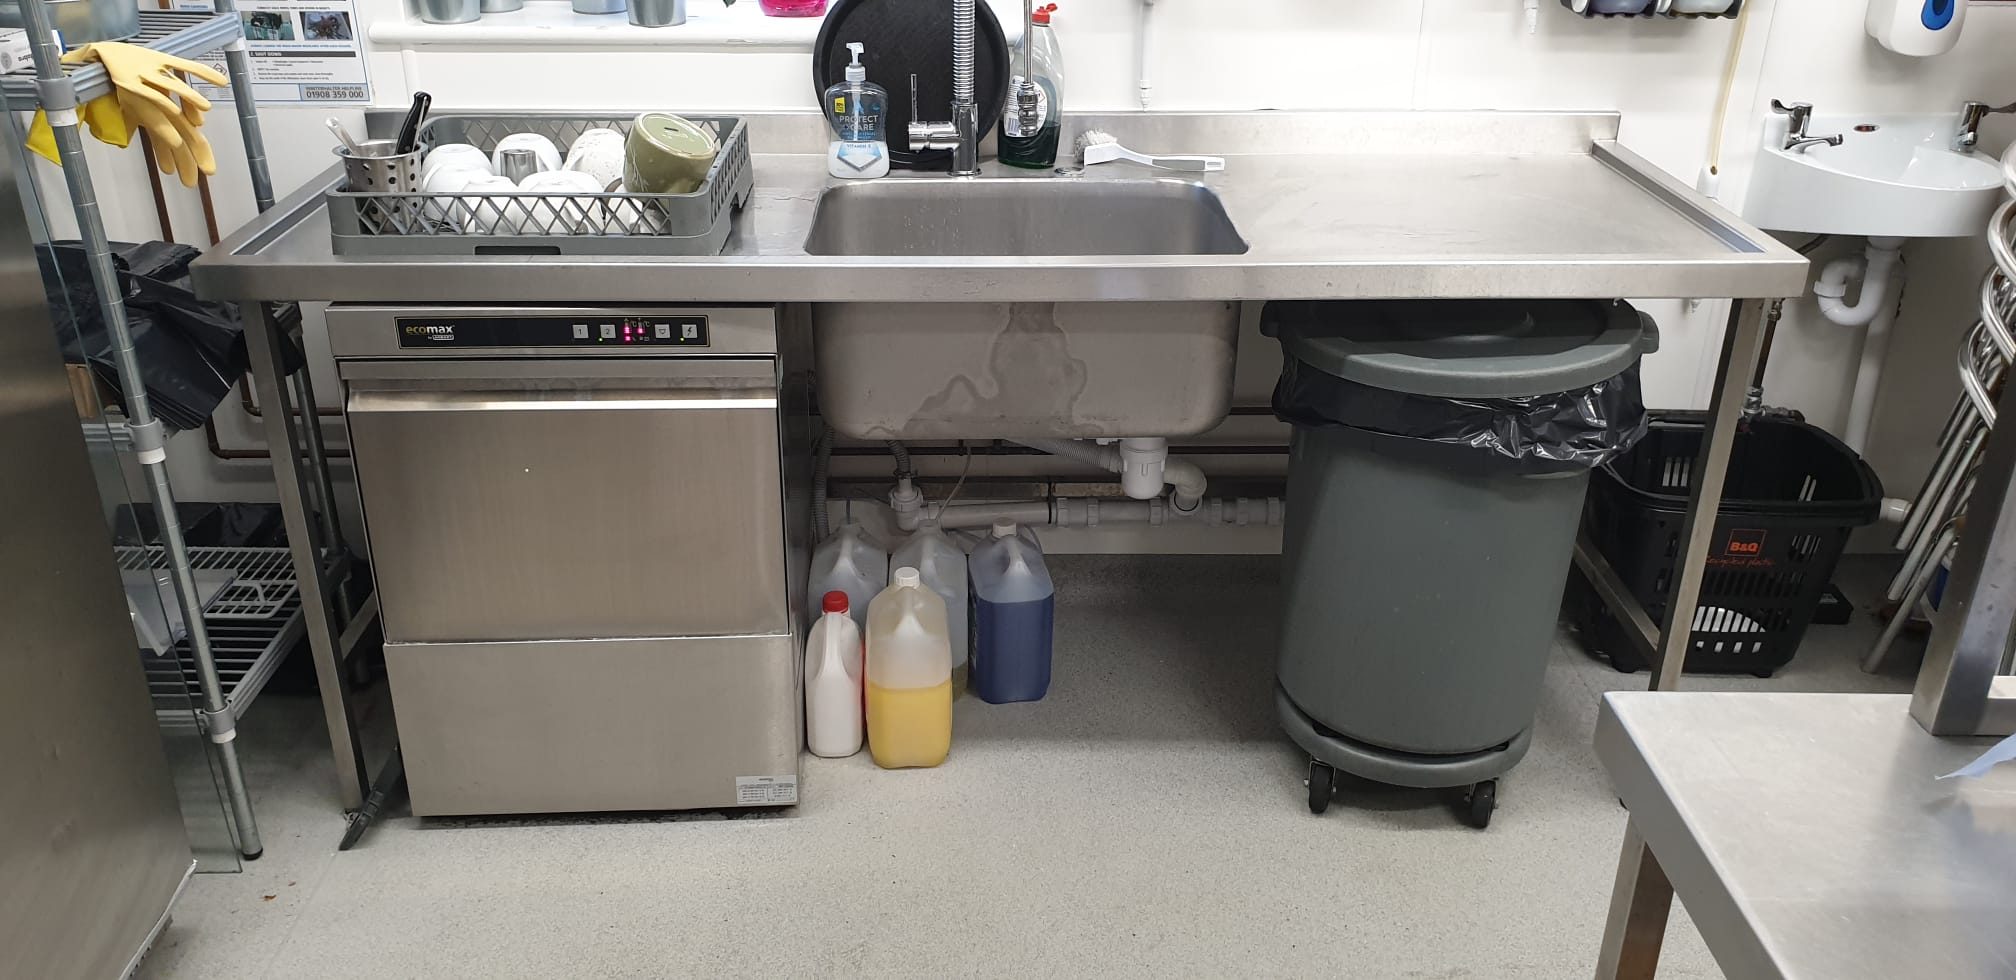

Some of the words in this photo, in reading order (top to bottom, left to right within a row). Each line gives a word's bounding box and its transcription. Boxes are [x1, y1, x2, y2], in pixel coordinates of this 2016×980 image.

[306, 91, 331, 99] 01908
[332, 91, 347, 99] 359
[349, 91, 364, 99] 000
[839, 115, 879, 123] PROTECT
[405, 325, 453, 334] ecomax
[1729, 541, 1759, 553] B&Q
